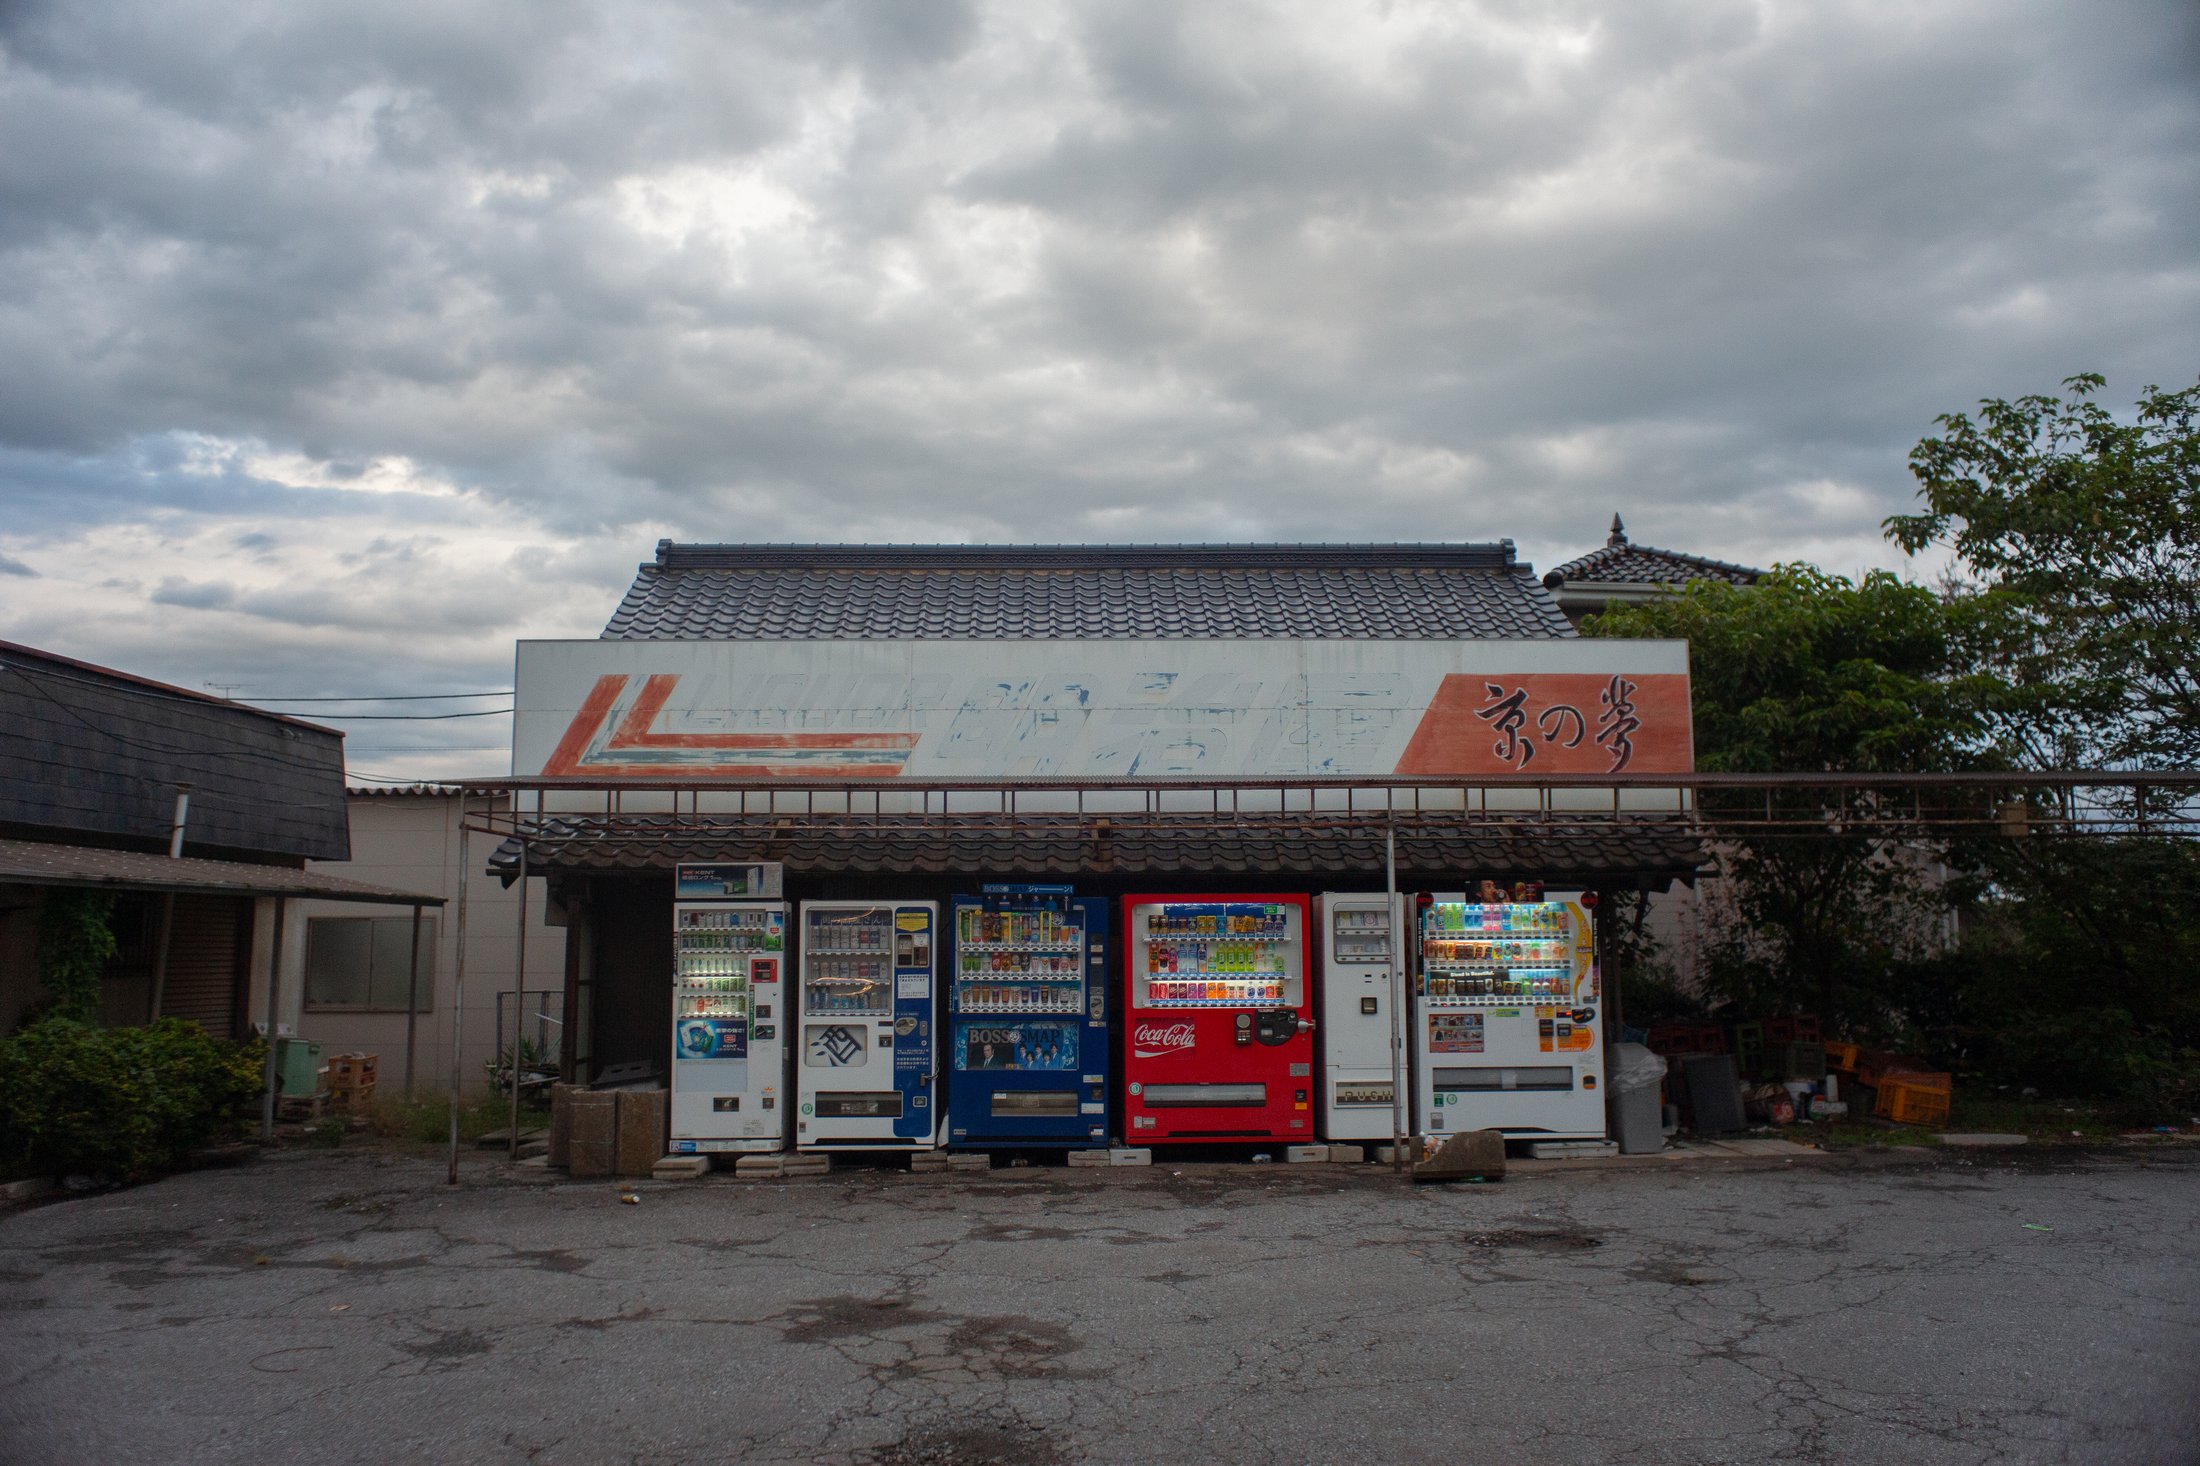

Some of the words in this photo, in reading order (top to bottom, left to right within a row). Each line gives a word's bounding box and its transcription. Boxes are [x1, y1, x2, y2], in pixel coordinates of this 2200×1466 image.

[968, 1029, 1011, 1044] BOSS
[1019, 1029, 1060, 1043] SMAP
[1134, 1023, 1196, 1047] Coca-Cola
[811, 1025, 862, 1067] 酒
[1344, 1090, 1391, 1102] PUSH
